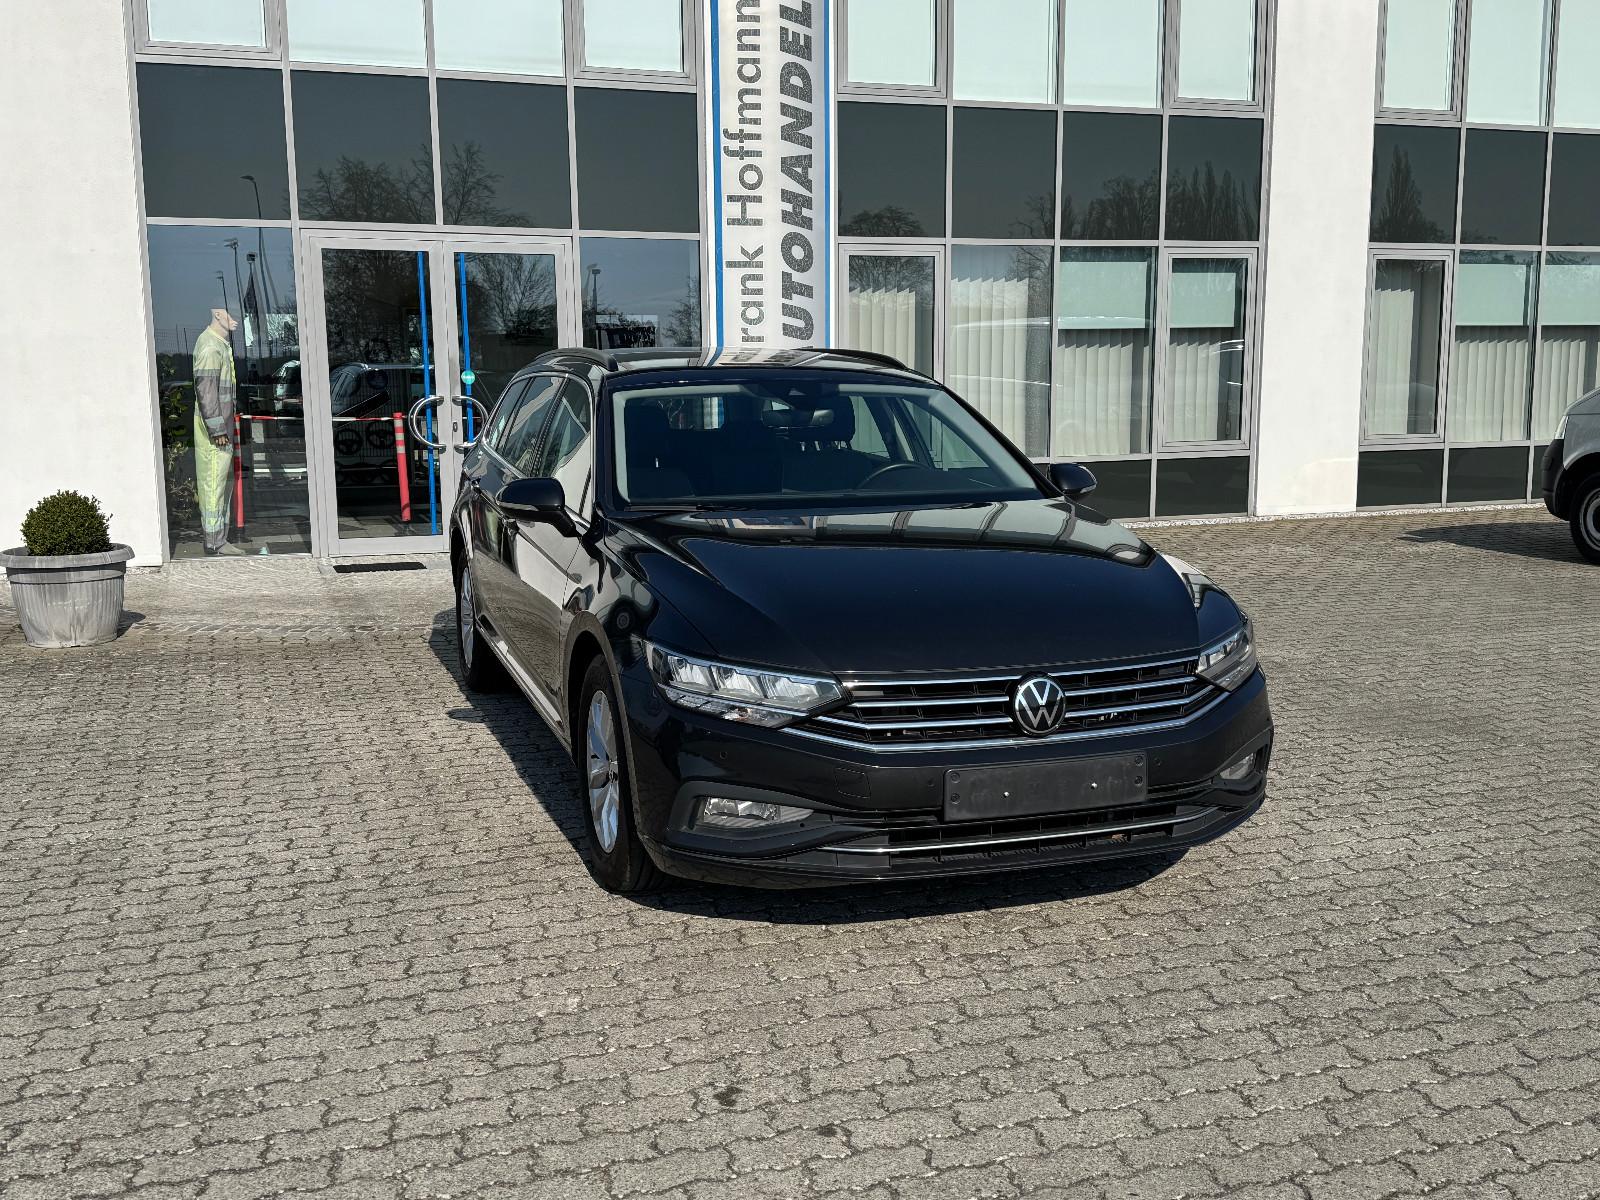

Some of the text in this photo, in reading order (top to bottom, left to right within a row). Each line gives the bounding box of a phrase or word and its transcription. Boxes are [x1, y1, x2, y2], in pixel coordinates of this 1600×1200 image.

[723, 0, 764, 343] rank Hoffmann
[779, 0, 814, 349] UTOHANDEL
[1016, 679, 1064, 732] VW
